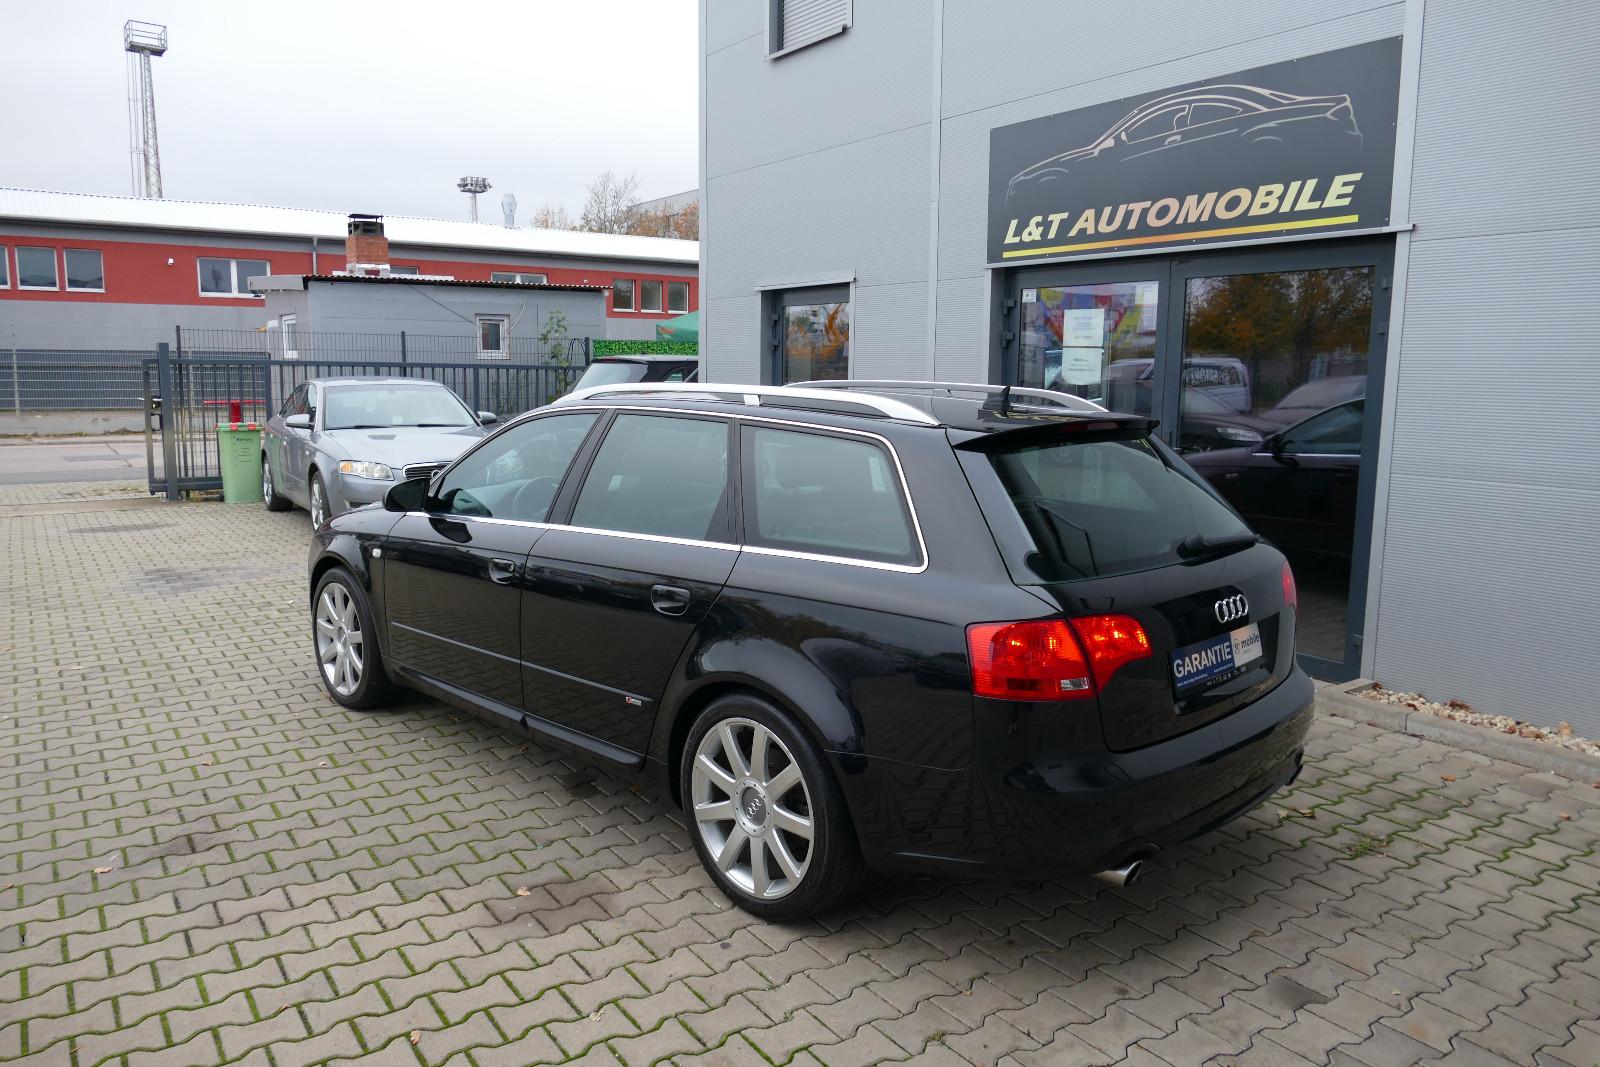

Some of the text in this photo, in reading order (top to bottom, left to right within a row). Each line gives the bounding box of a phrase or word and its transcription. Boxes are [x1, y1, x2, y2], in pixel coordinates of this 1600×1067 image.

[1003, 173, 1363, 245] L&T AUTOMOBILE
[1173, 641, 1232, 678] GARANTIE
